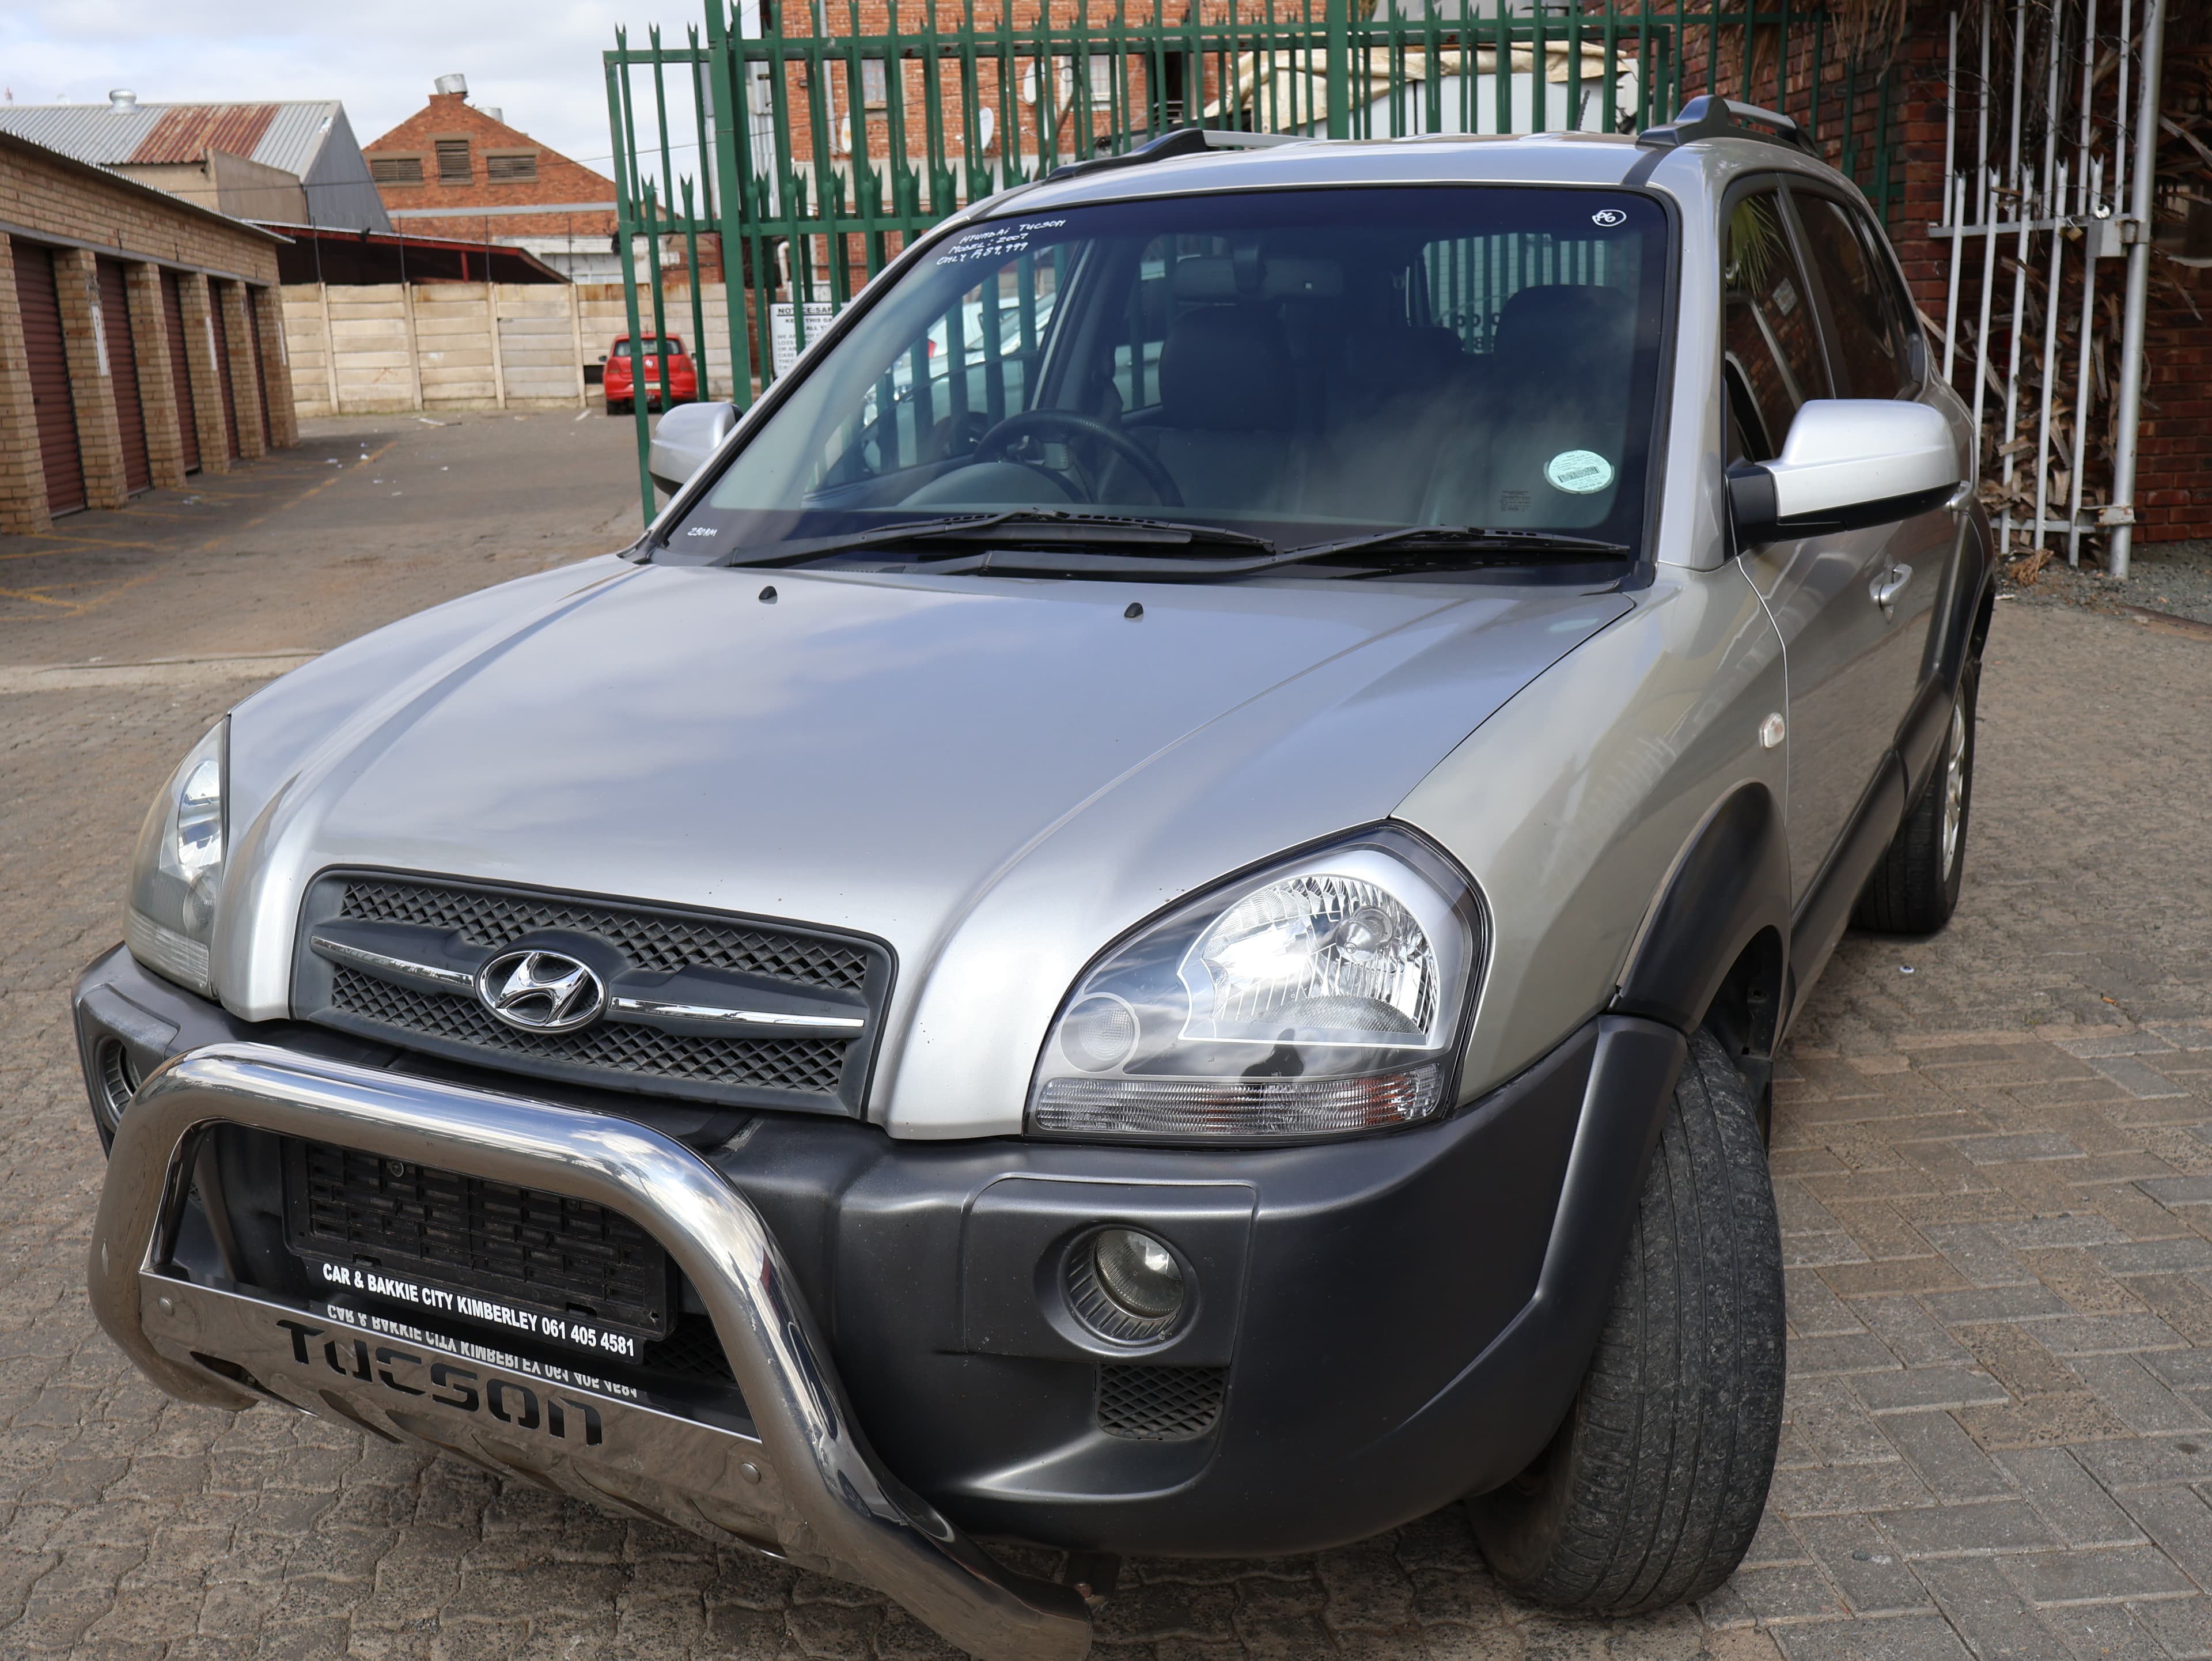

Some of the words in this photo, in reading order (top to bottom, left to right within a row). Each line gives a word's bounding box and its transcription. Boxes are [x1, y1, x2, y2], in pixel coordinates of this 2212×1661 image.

[1019, 220, 1066, 232] TUCSON
[996, 233, 1028, 243] 2007
[937, 253, 967, 265] ONLY
[323, 1263, 351, 1285] CAR
[354, 1270, 364, 1289] &
[367, 1274, 419, 1302] BAKKIE
[422, 1288, 453, 1310] CITY
[456, 1295, 537, 1331] KIMBERLEY
[541, 1317, 566, 1339] 061
[571, 1325, 596, 1347] 405
[600, 1332, 634, 1356] 4581
